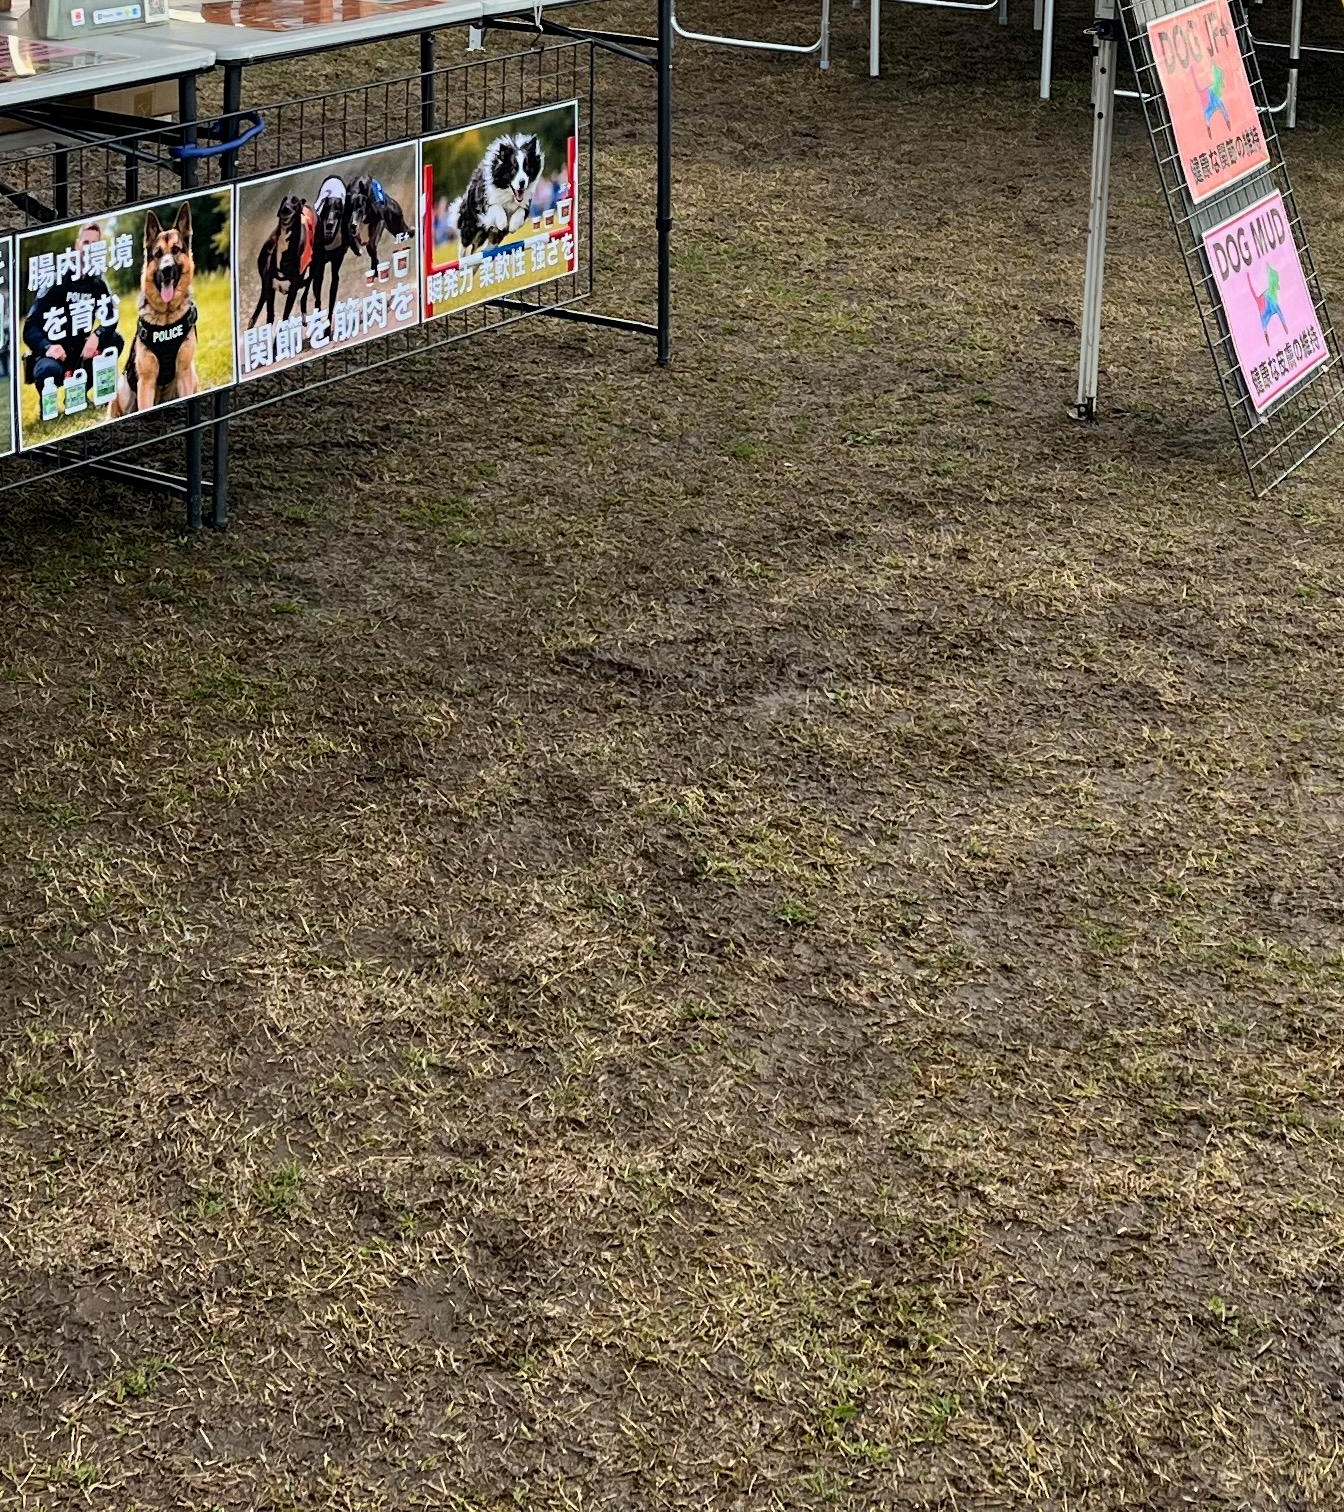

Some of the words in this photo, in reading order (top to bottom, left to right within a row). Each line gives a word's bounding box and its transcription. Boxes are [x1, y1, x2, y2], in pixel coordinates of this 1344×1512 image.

[1158, 20, 1202, 74] DOG
[28, 233, 133, 291] 腸内環境
[480, 246, 526, 288] 柔軟性
[531, 233, 574, 272] 強さを
[1212, 227, 1253, 281] DOG
[1249, 207, 1286, 259] MUD
[43, 293, 120, 341] を育む
[152, 325, 183, 343] POLICE
[243, 282, 414, 373] 関節を筋肉を
